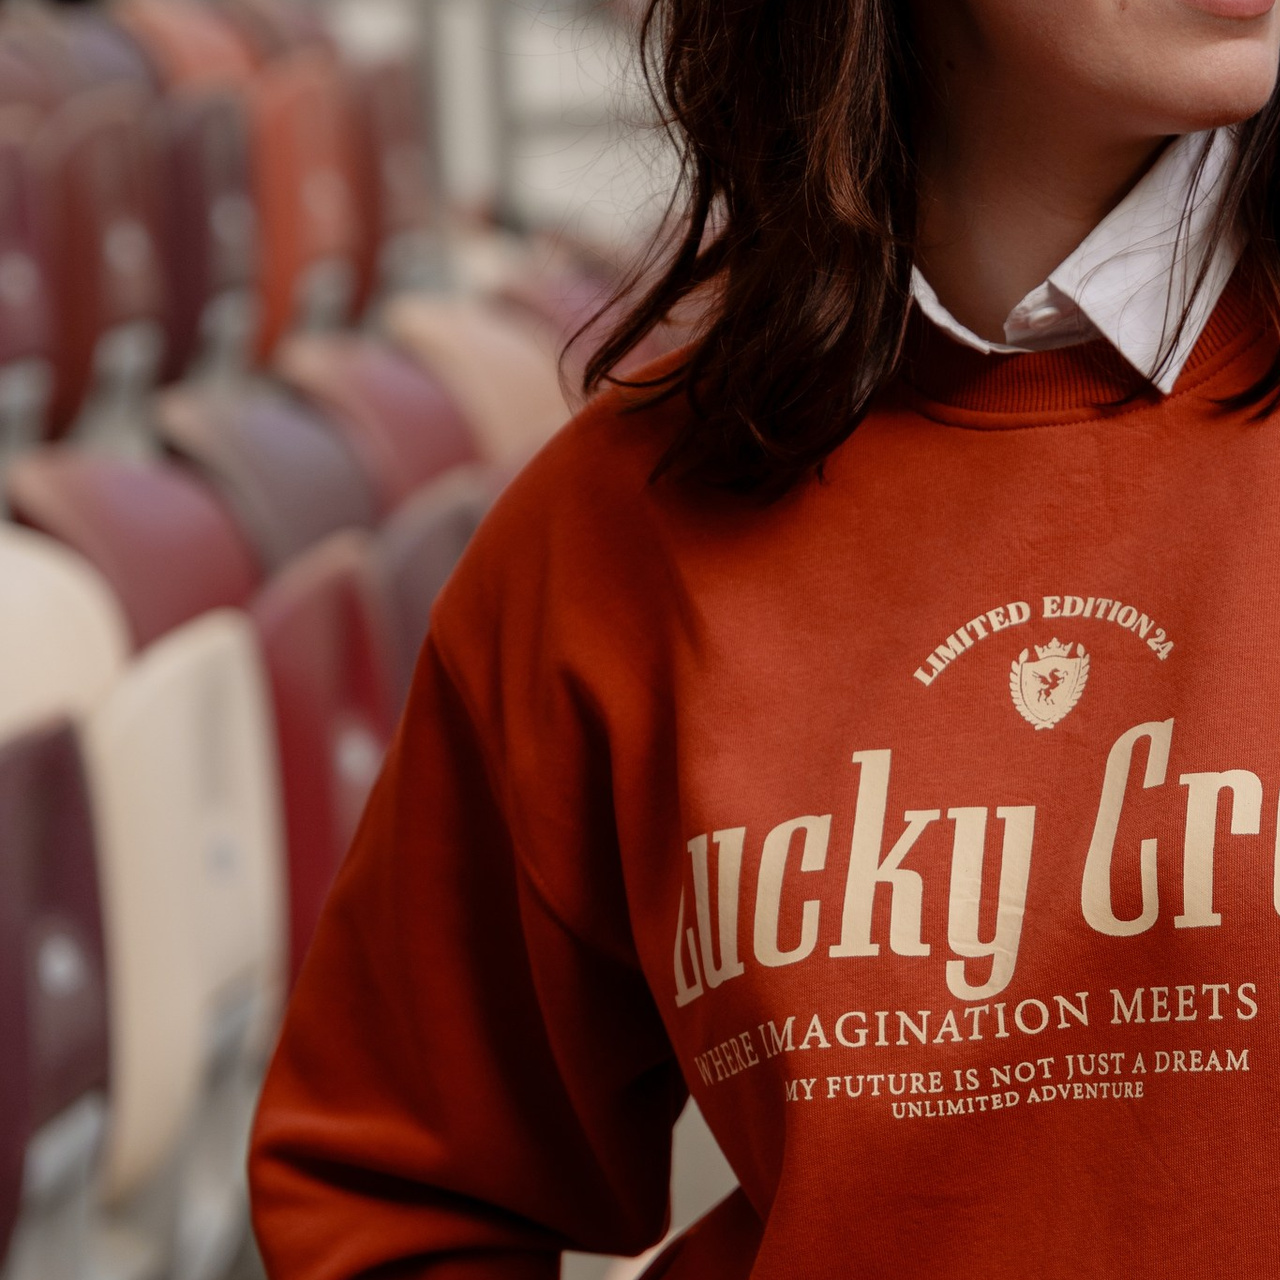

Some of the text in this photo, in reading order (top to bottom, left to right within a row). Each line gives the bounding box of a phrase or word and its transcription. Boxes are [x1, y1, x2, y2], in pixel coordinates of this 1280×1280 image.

[913, 601, 1031, 687] LIMITED
[694, 1030, 760, 1087] WHERE
[759, 992, 1089, 1060] IMAGINATION
[1110, 983, 1258, 1024] MEETS
[785, 1049, 1250, 1102] MY FUTURE IS NOT JUST A DREAM
[891, 1082, 1144, 1119] UNLIMITED ADVENTURE
